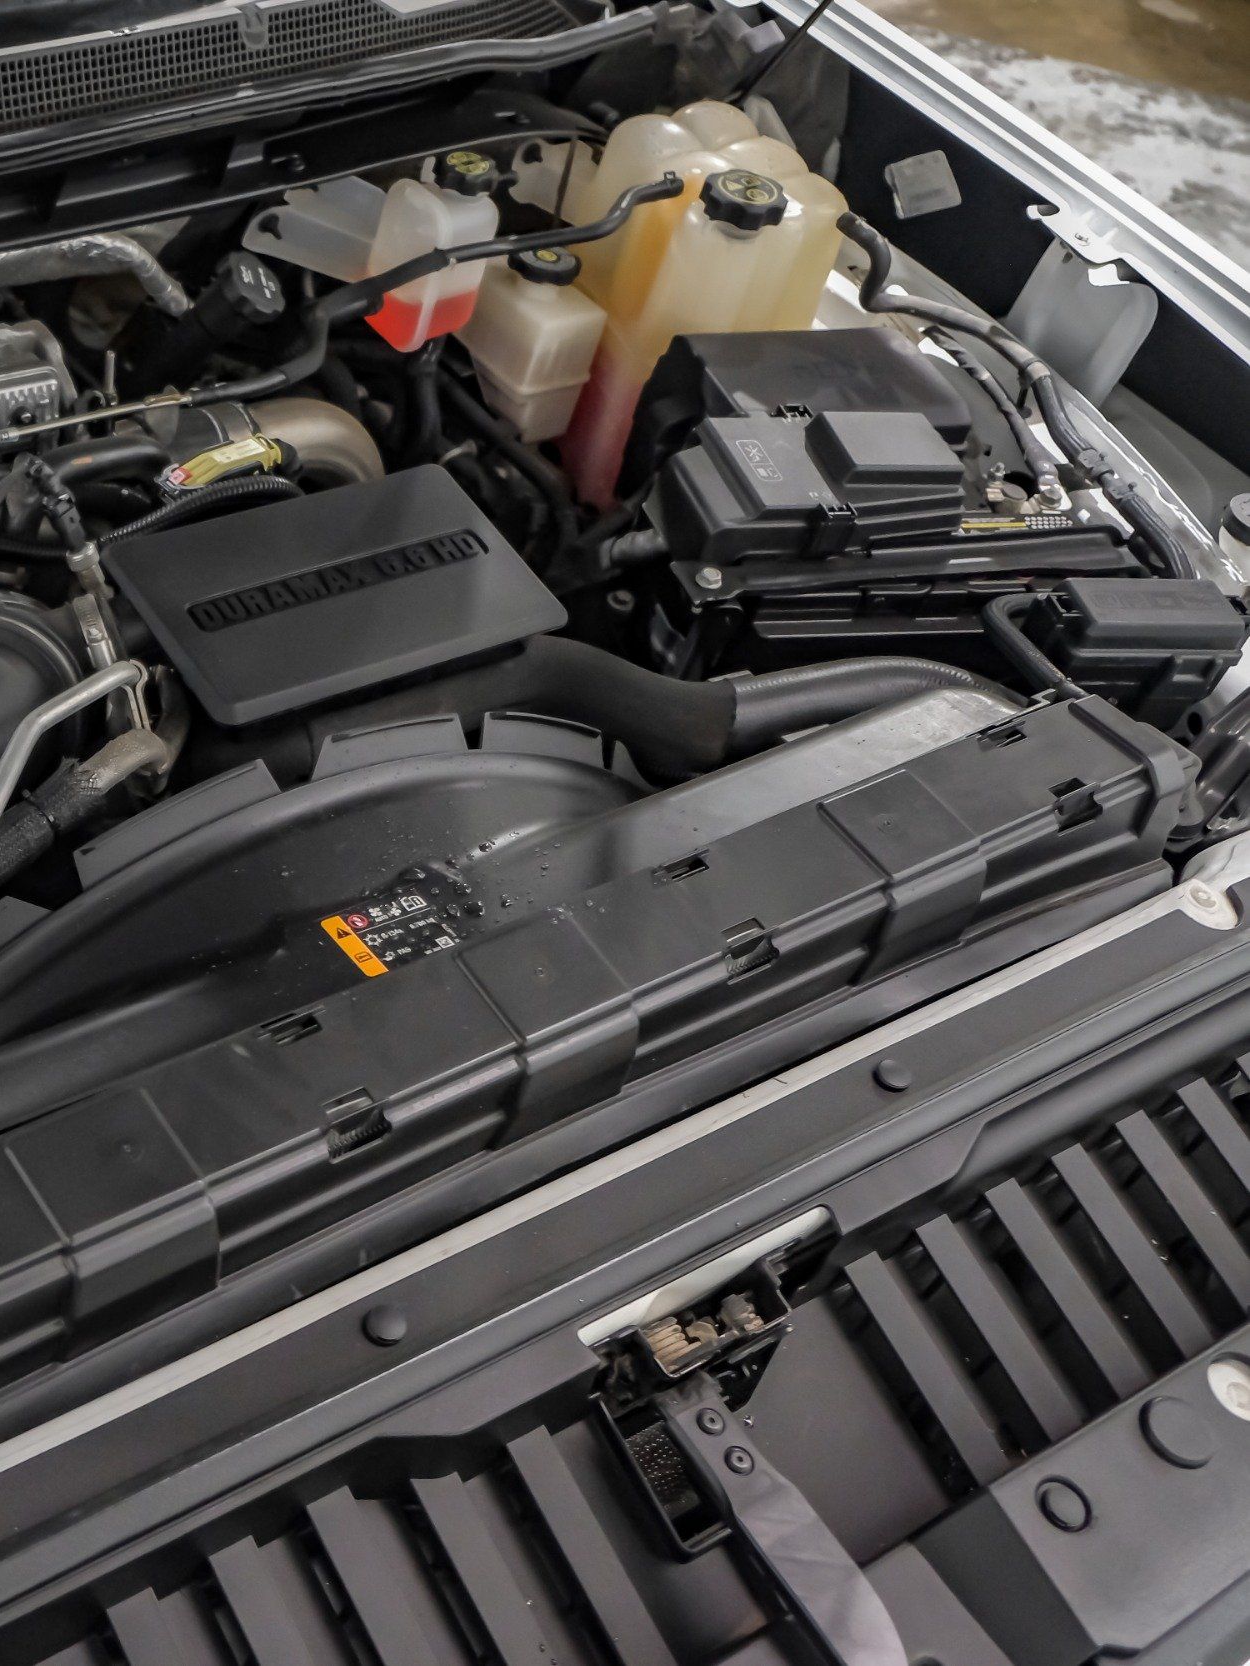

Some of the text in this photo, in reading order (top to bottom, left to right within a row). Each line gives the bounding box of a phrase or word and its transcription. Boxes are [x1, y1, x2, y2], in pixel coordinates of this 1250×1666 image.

[193, 532, 481, 630] DURAMAX 6.6 HD
